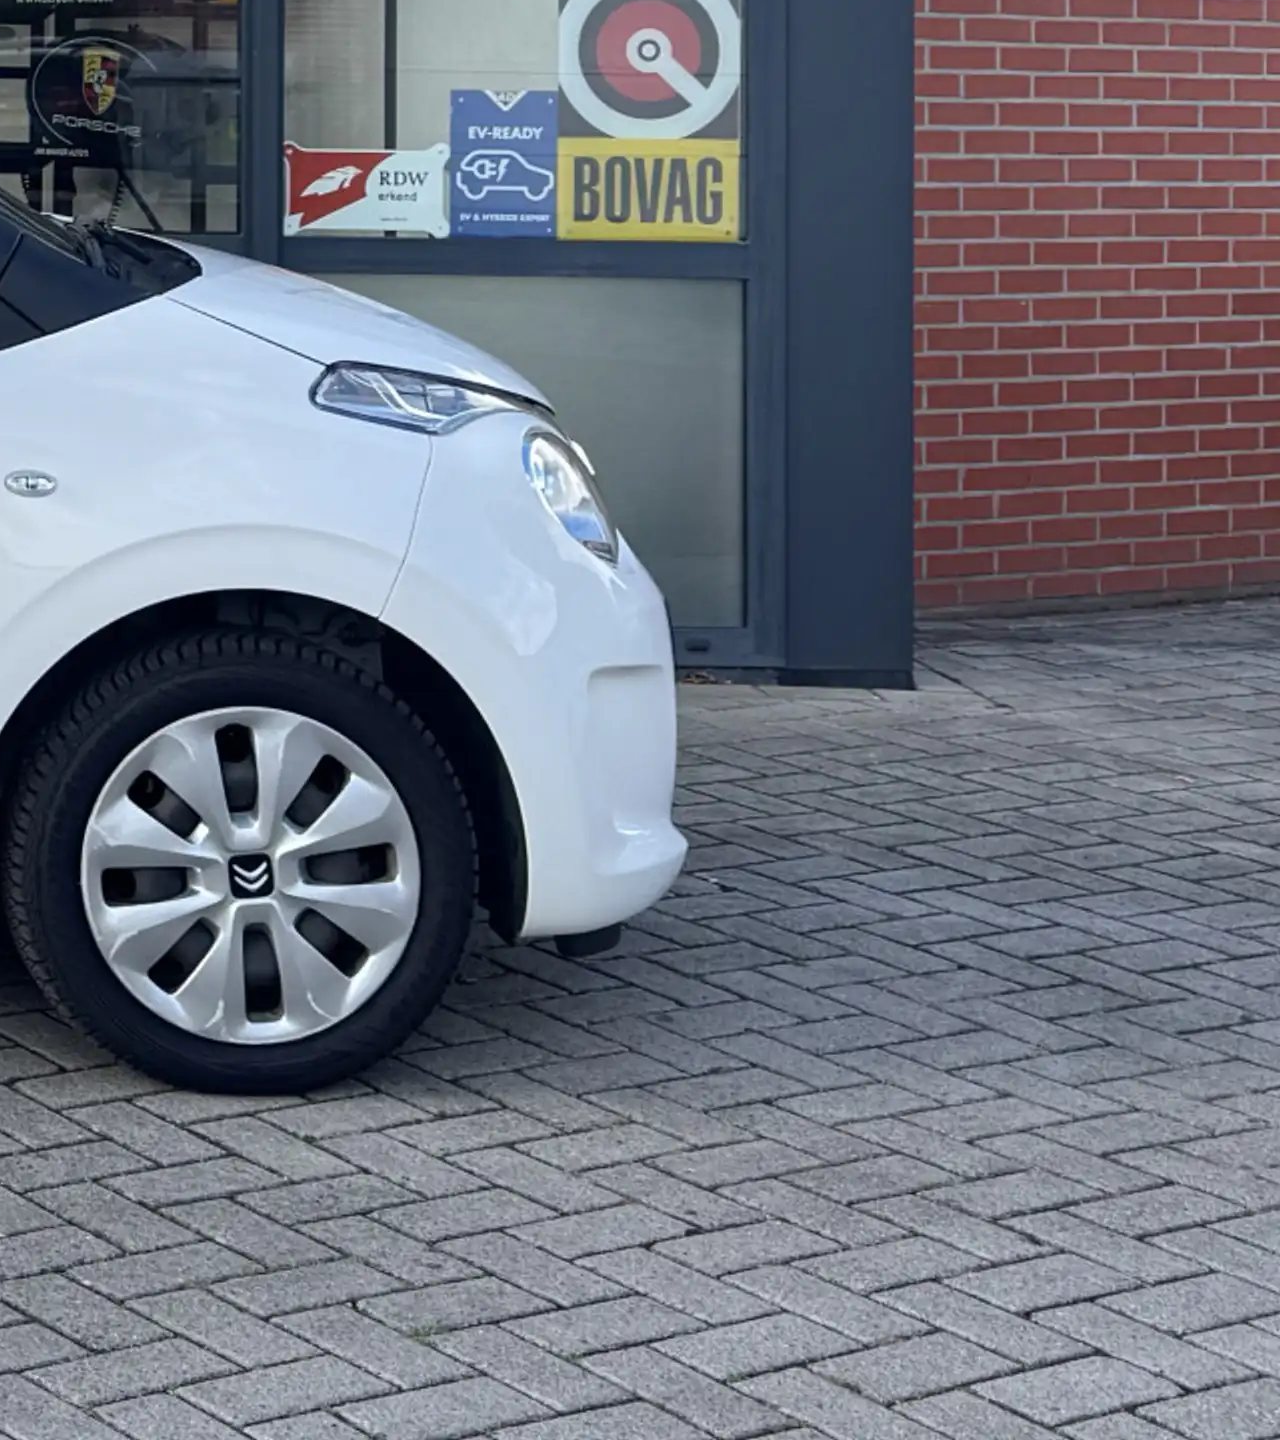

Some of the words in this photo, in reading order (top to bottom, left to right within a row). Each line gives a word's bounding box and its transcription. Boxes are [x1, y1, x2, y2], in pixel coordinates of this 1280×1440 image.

[51, 114, 142, 138] PORSCHE
[467, 126, 544, 140] EV-READY
[379, 170, 429, 187] RDW
[378, 190, 417, 202] erkend
[572, 155, 724, 225] BOVAG
